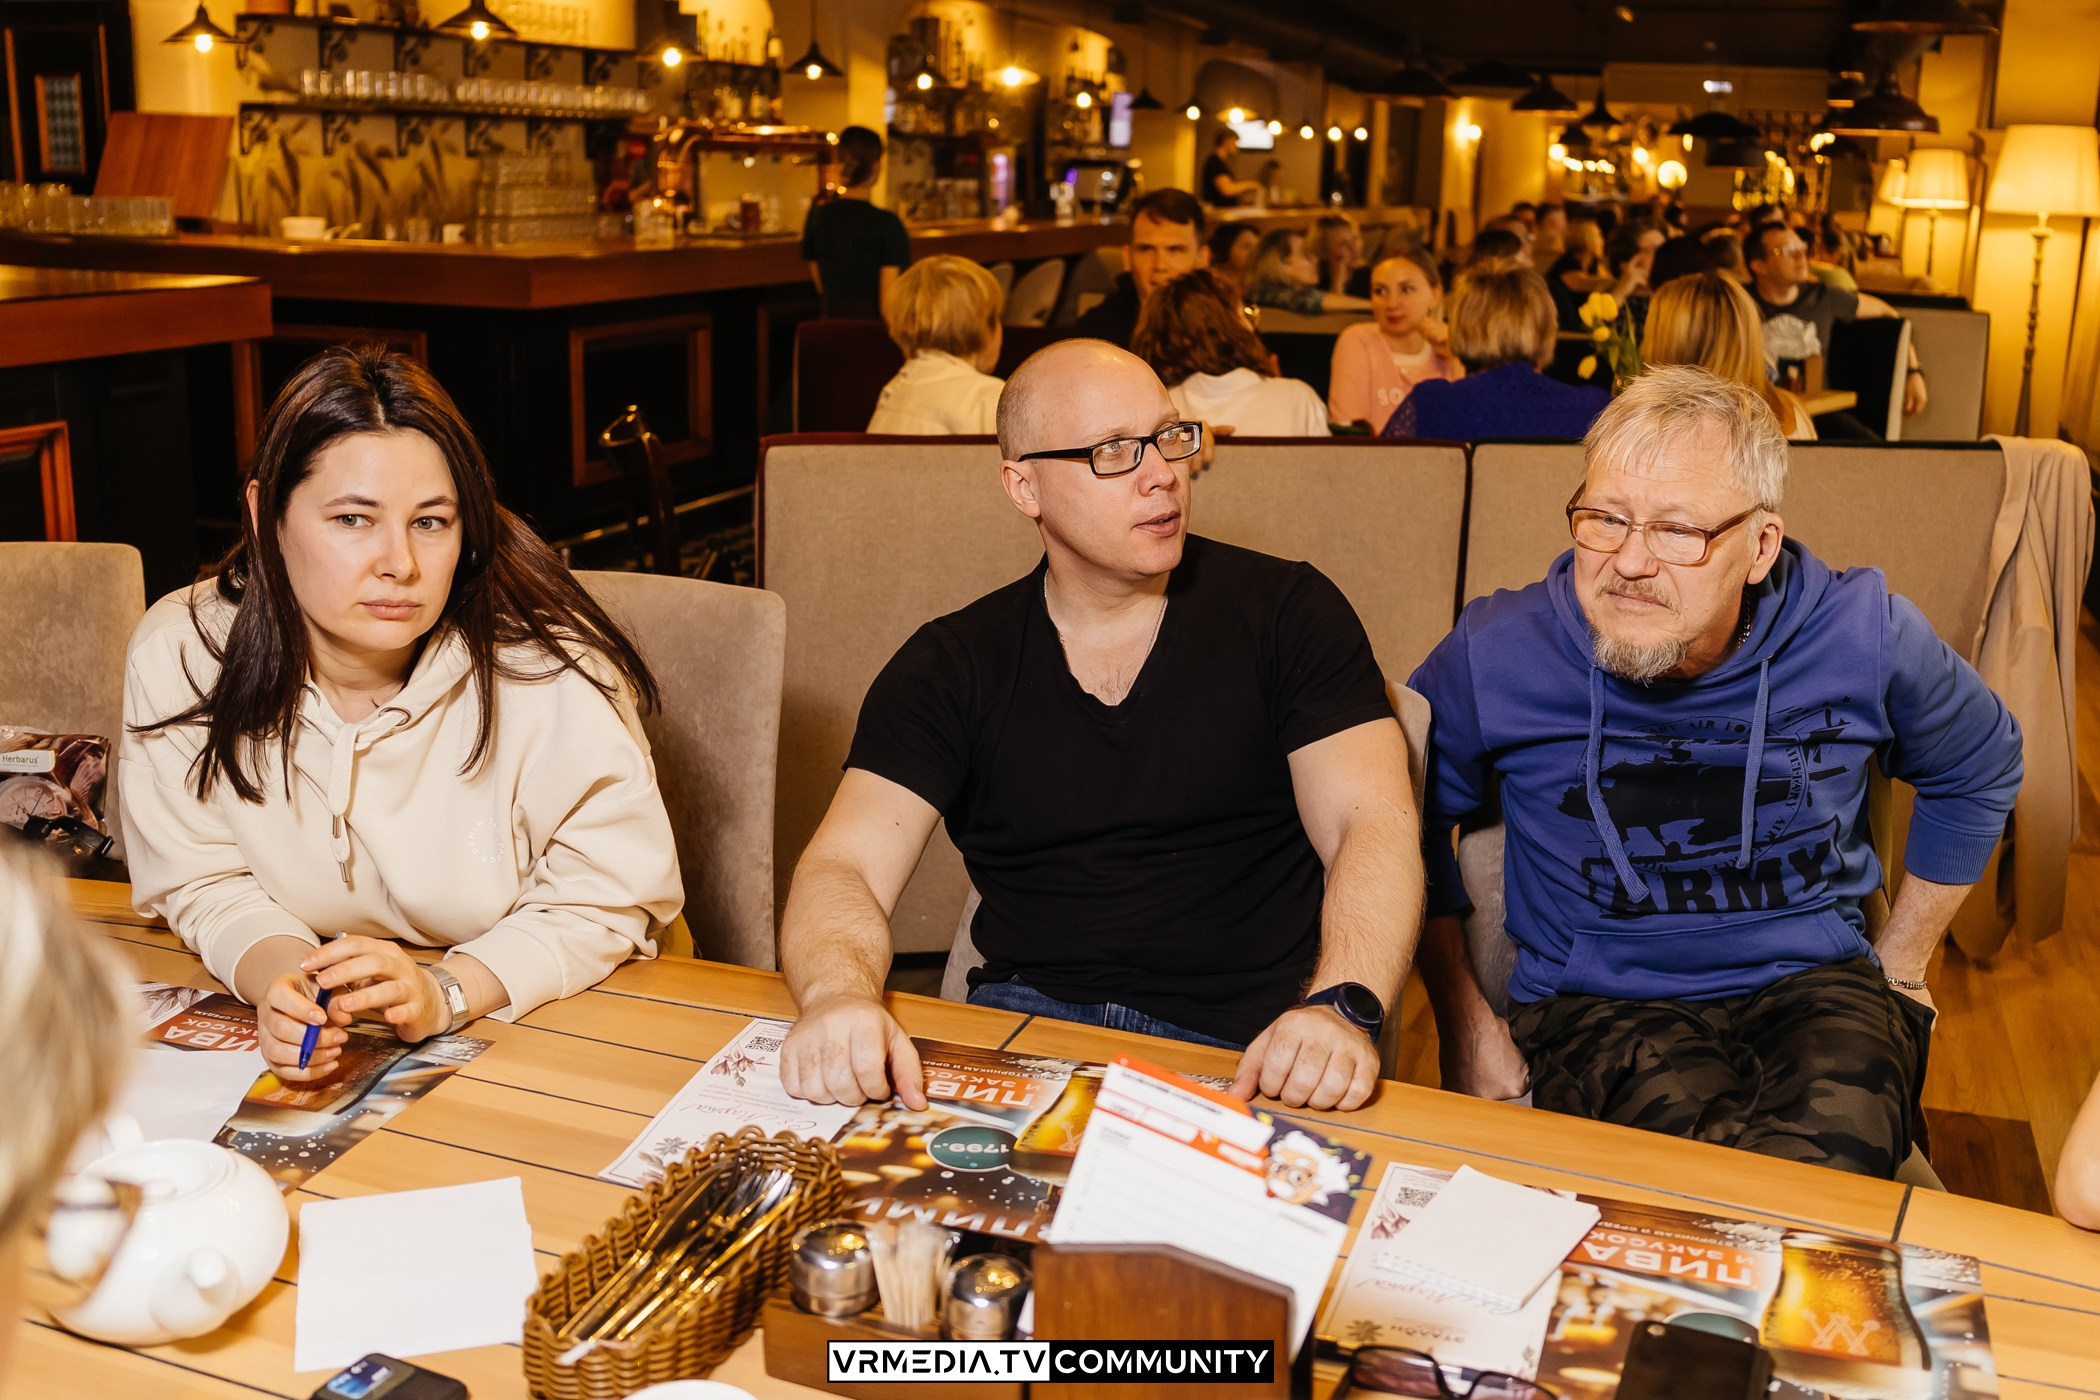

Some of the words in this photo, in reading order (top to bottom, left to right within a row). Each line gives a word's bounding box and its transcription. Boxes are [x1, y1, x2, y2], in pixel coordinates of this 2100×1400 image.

[1376, 386, 1404, 407] SO
[2, 755, 39, 764] Herbarus
[164, 1025, 258, 1052] ИВА
[181, 1018, 259, 1037] АКУСОК
[923, 1060, 951, 1068] СРЕД
[925, 1080, 1035, 1107] ПИВ
[1589, 1230, 1724, 1261] ЗАКУСОК
[1582, 1240, 1752, 1286] ПИВА
